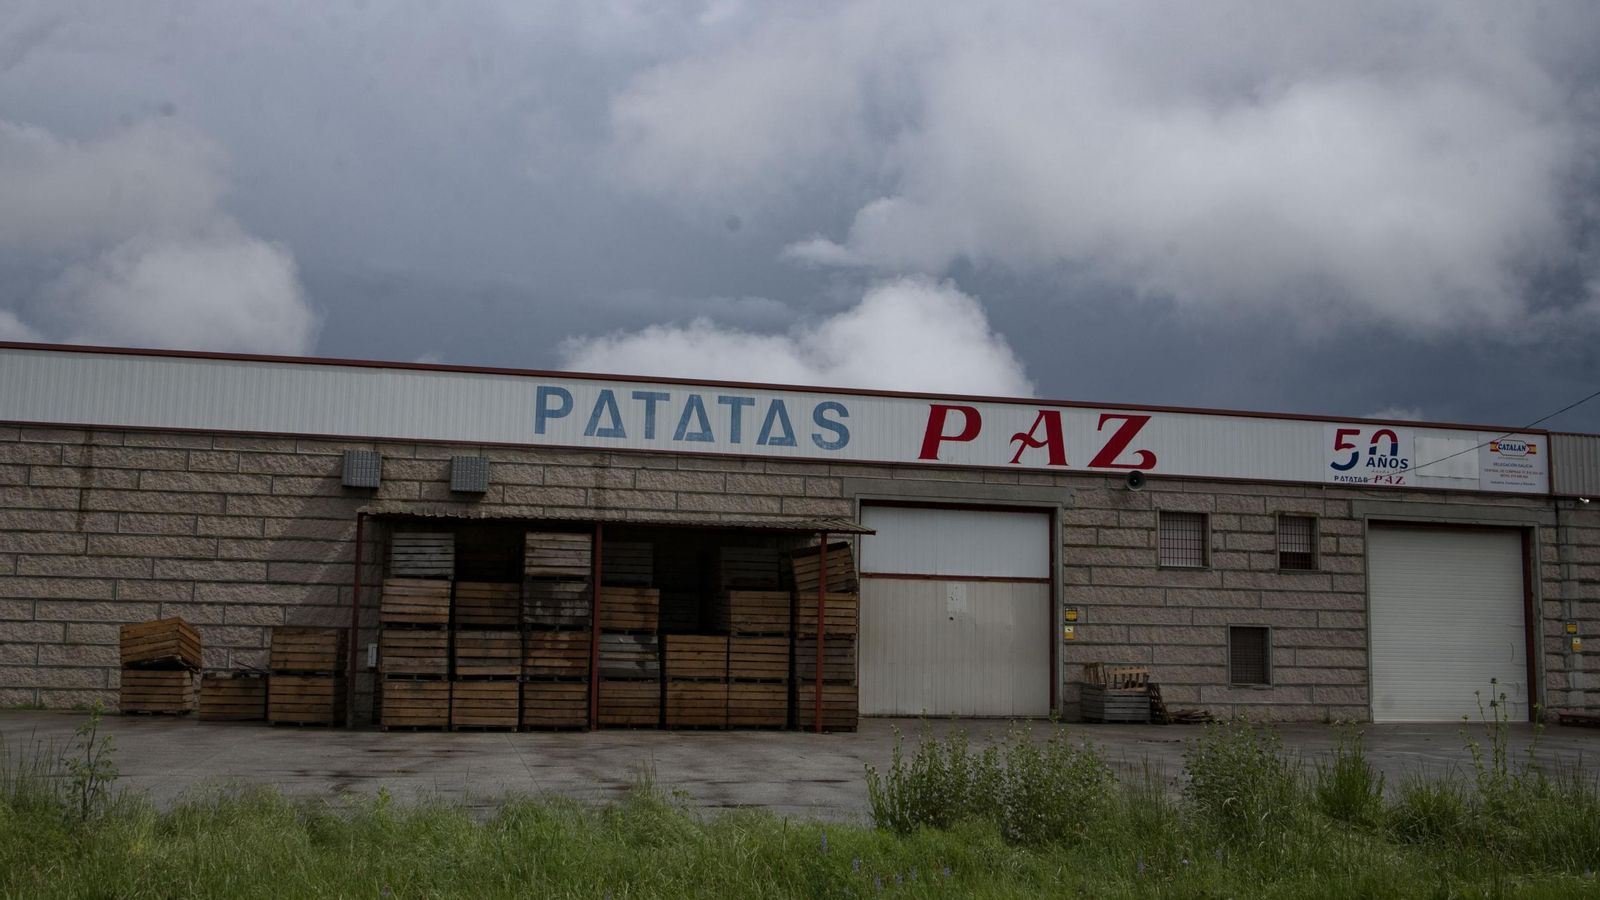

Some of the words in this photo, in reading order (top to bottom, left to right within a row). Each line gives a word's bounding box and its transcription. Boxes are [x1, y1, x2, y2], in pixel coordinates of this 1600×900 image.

[534, 385, 850, 451] PATATAS
[918, 403, 1157, 470] PAZ
[1330, 428, 1398, 471] 50
[1366, 454, 1408, 469] AÑOS
[1334, 475, 1368, 483] PATATAS
[1374, 475, 1406, 485] PAZ
